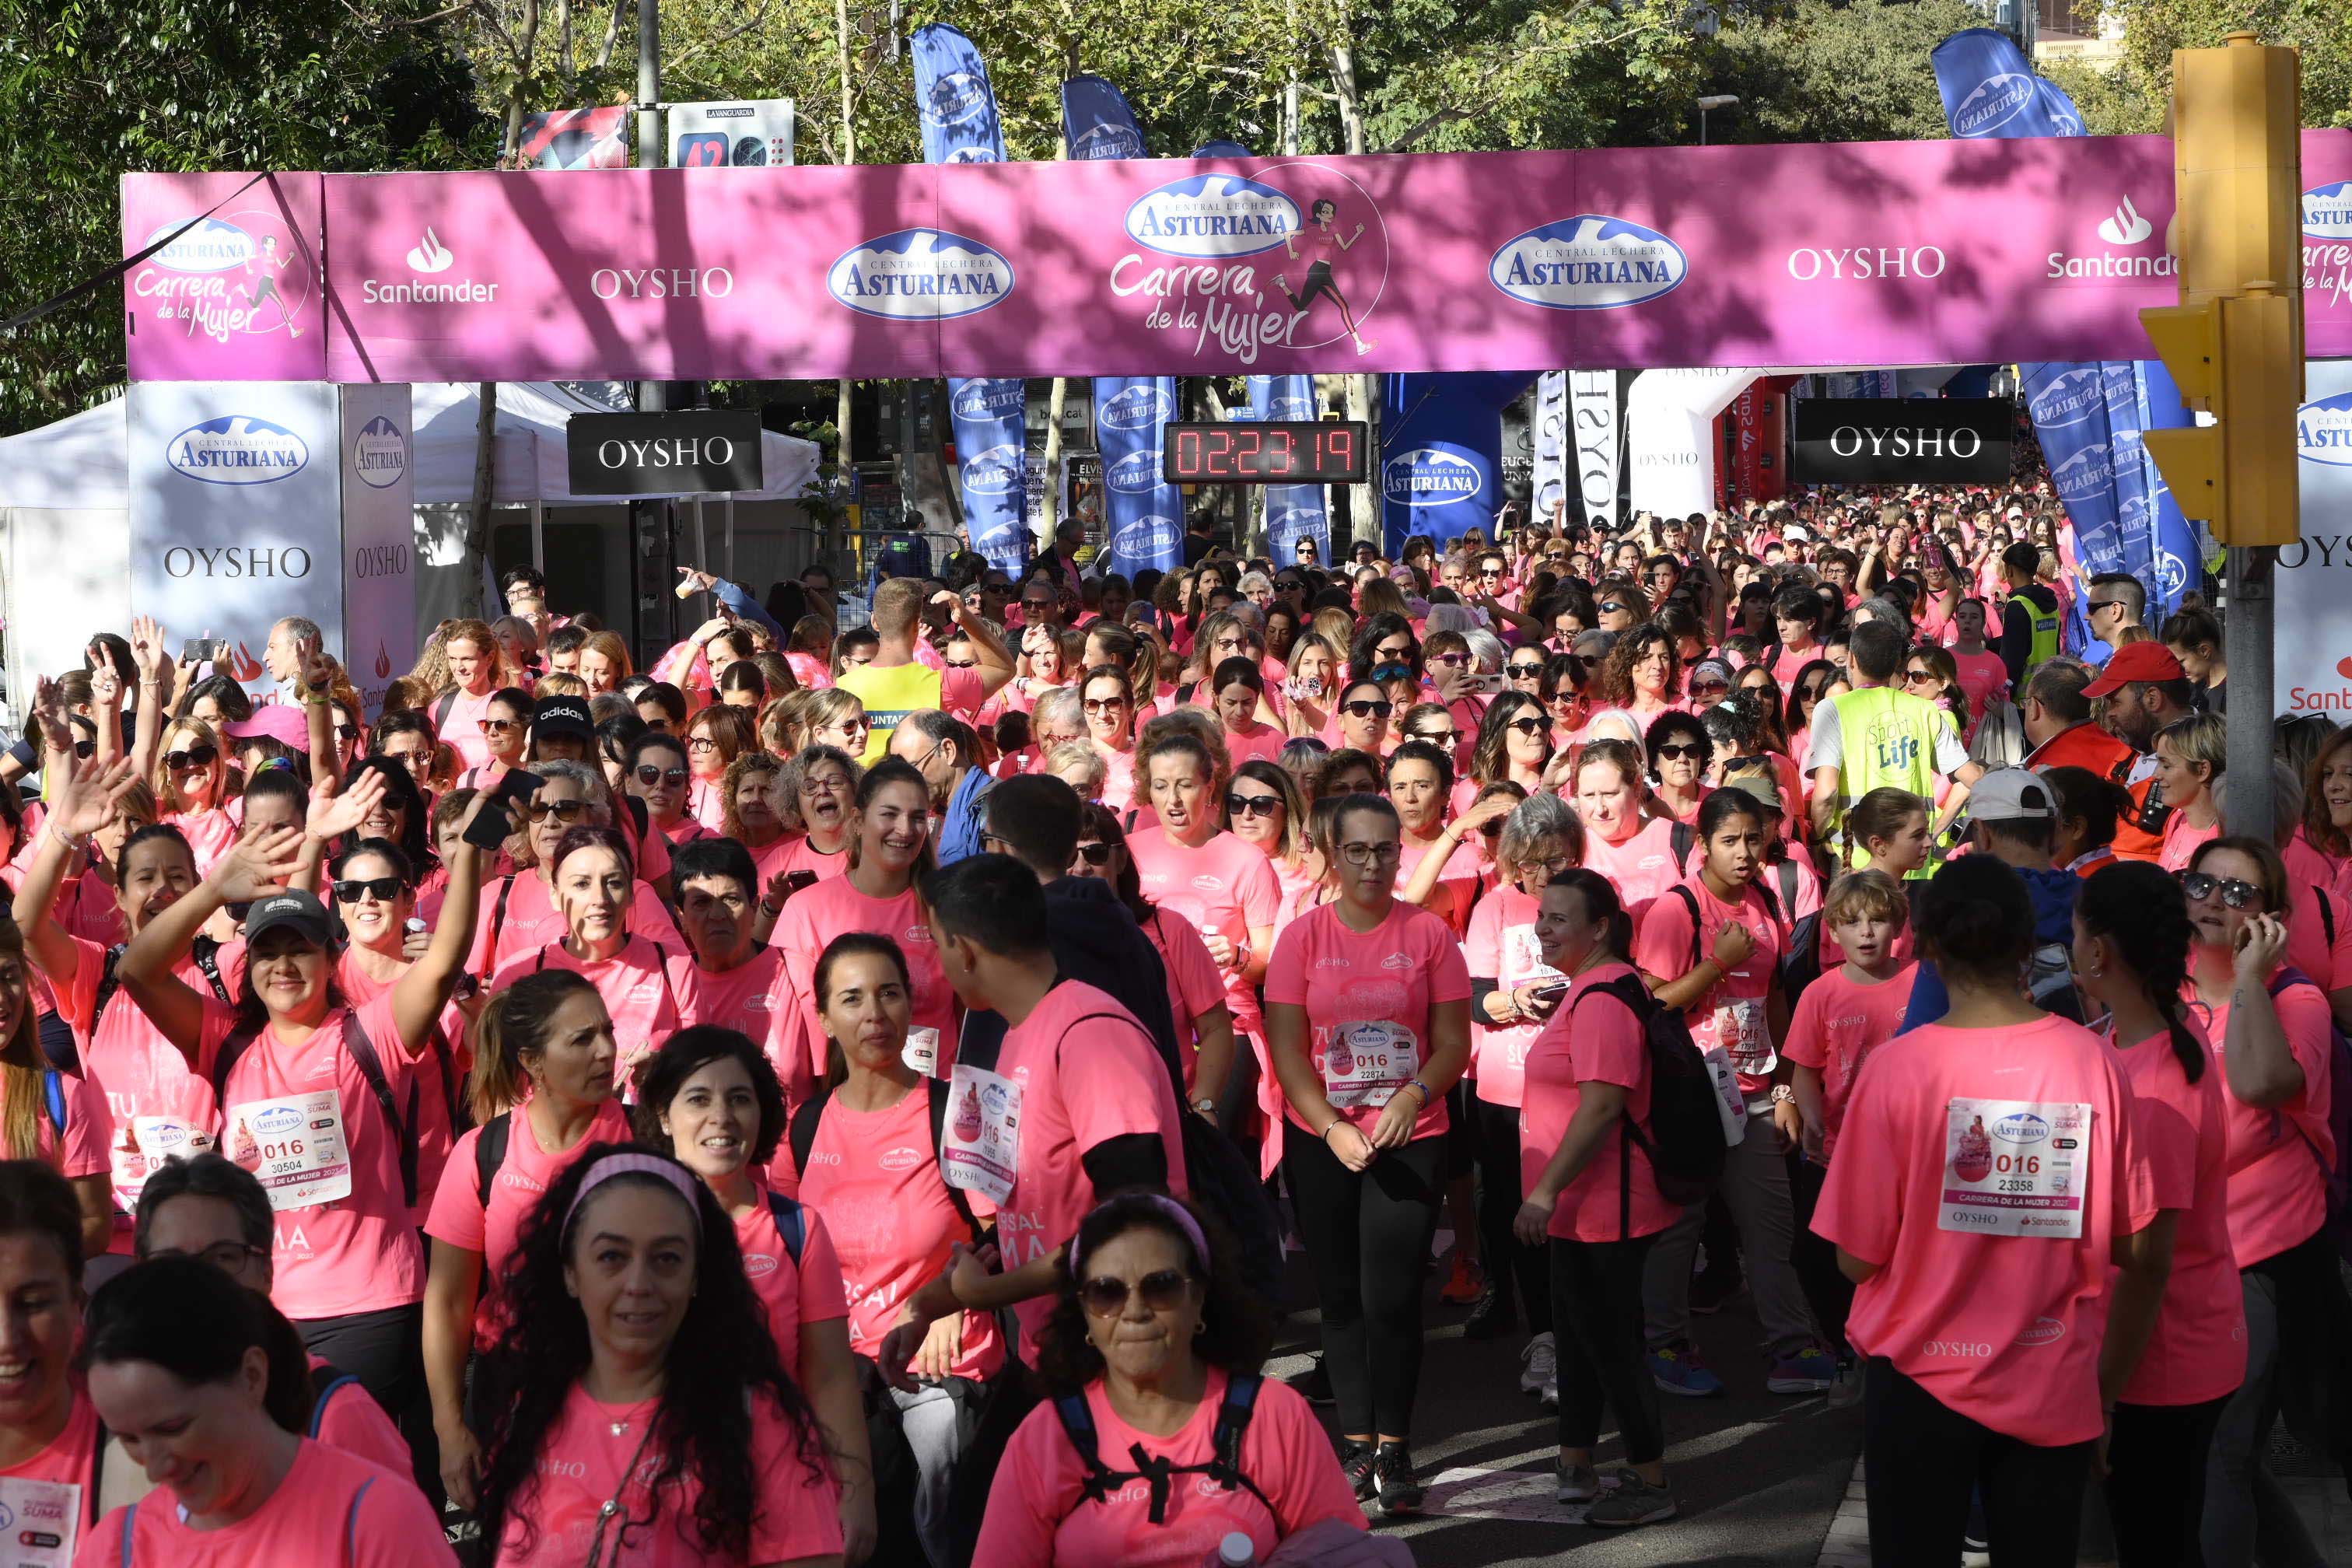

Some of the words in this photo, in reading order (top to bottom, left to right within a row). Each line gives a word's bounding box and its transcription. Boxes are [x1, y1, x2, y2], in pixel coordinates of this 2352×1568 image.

[1139, 205, 1288, 236] ASTURIANA
[1535, 248, 1597, 258] CENTRAL
[1788, 246, 1946, 280] OYSHO
[1110, 254, 1255, 297] Carrera
[1504, 251, 1671, 286] ASTURIANA
[2047, 252, 2178, 278] Santand
[135, 268, 226, 299] Carrera
[590, 267, 733, 299] OYSHO
[842, 263, 1000, 296] ASTURIANA
[2319, 268, 2333, 289] la
[362, 279, 498, 303] Santander
[157, 297, 175, 319] de
[178, 296, 190, 319] la
[188, 296, 261, 343] Mujer
[1145, 299, 1172, 330] de
[1178, 298, 1198, 330] la
[1194, 292, 1309, 365] Mujer
[598, 436, 733, 469] OYSHO
[1178, 431, 1351, 474] 02:23:19
[1830, 426, 1982, 458] OYSHO
[177, 441, 299, 467] ASTURIANA
[359, 443, 404, 471] ASTURIANA
[1386, 470, 1474, 492] ASTURIANA
[164, 547, 311, 579] OYSHO
[355, 544, 408, 579] OYSHO
[540, 707, 584, 721] adidas
[1868, 719, 1912, 746] Sport
[1878, 735, 1919, 770] Life
[1829, 1013, 1866, 1030] OYSHO
[1356, 1054, 1388, 1067] 016
[1361, 1070, 1385, 1080] 22874
[307, 1104, 331, 1114] SUMA
[257, 1116, 300, 1130] ASTURIANA
[1997, 1124, 2044, 1136] ASTURIANA
[264, 1139, 304, 1160] 016
[271, 1160, 302, 1174] 30504
[1996, 1154, 2040, 1174] 016
[297, 1172, 320, 1181] MUJER
[502, 1172, 544, 1192] OYSH
[1998, 1179, 2033, 1192] 23358
[1958, 1194, 1999, 1203] CARRERA
[2000, 1196, 2013, 1205] DE
[1953, 1212, 1997, 1225] OYSHO
[2032, 1216, 2070, 1227] Santander
[1923, 1341, 1992, 1358] OYSHO
[1108, 1486, 1149, 1505] SHO
[23, 1507, 63, 1520] SUMA
